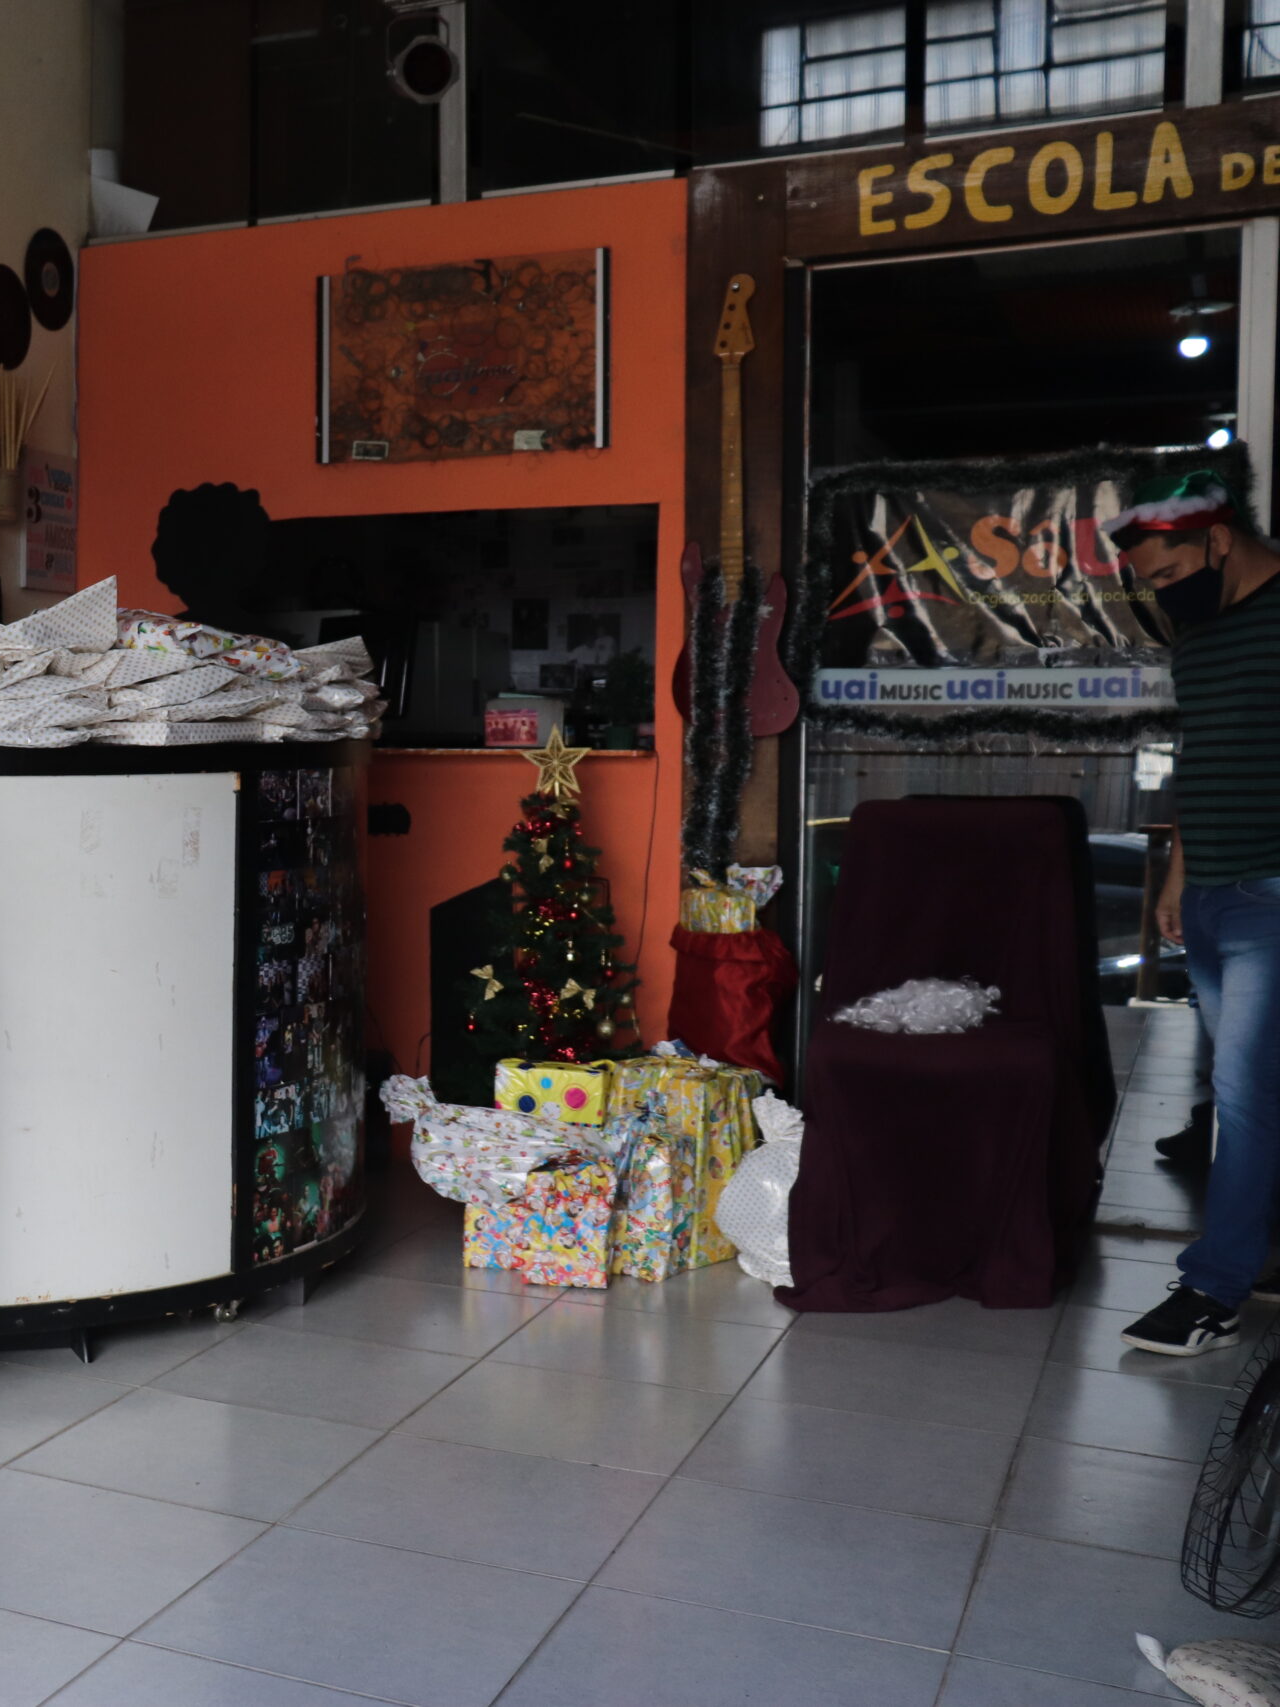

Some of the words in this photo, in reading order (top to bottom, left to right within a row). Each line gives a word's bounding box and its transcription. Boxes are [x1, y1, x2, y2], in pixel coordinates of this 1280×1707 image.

[858, 121, 1194, 236] ESCOLA
[1221, 145, 1280, 192] DE
[821, 672, 877, 700] uai
[880, 684, 942, 701] MUSIC
[946, 671, 1005, 700] uai
[1007, 682, 1073, 700] MUSIC
[1078, 668, 1140, 699] uai
